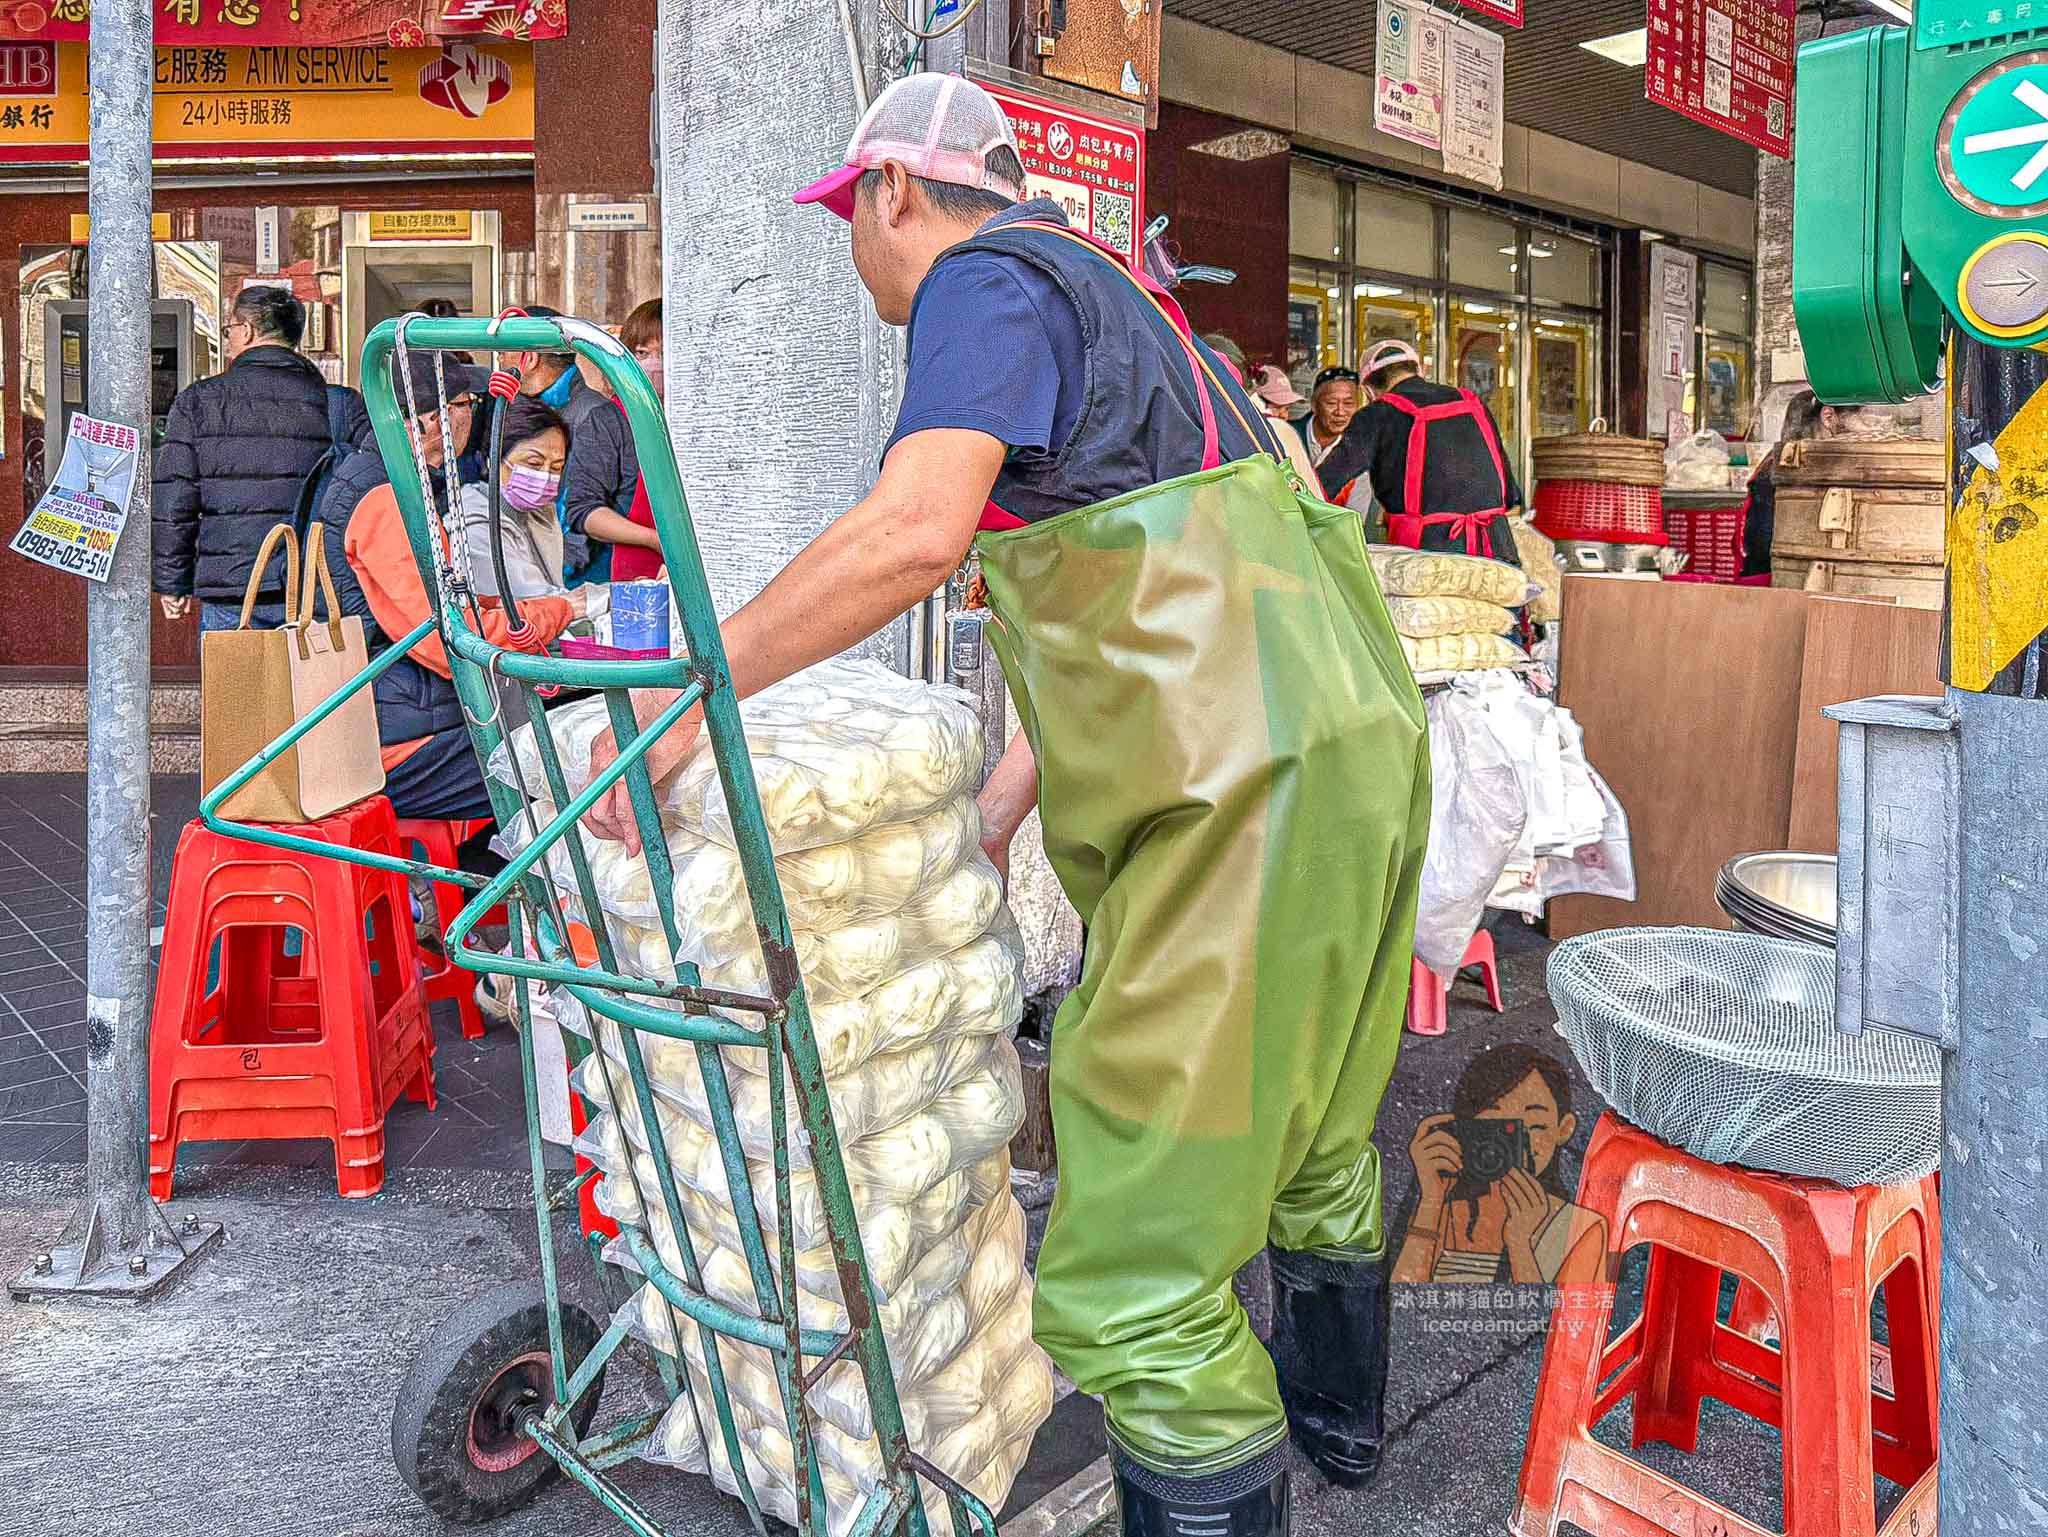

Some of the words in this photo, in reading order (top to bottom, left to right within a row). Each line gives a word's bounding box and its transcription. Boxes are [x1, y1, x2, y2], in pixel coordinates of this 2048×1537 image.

[246, 48, 290, 85] ATM
[295, 46, 389, 84] SERVICE
[0, 104, 54, 129] 銀行
[182, 98, 292, 126] 24小時服務
[1079, 134, 1135, 163] 肉包專賣店
[383, 213, 457, 228] 自動存提款機
[16, 529, 110, 579] 0983-025-514
